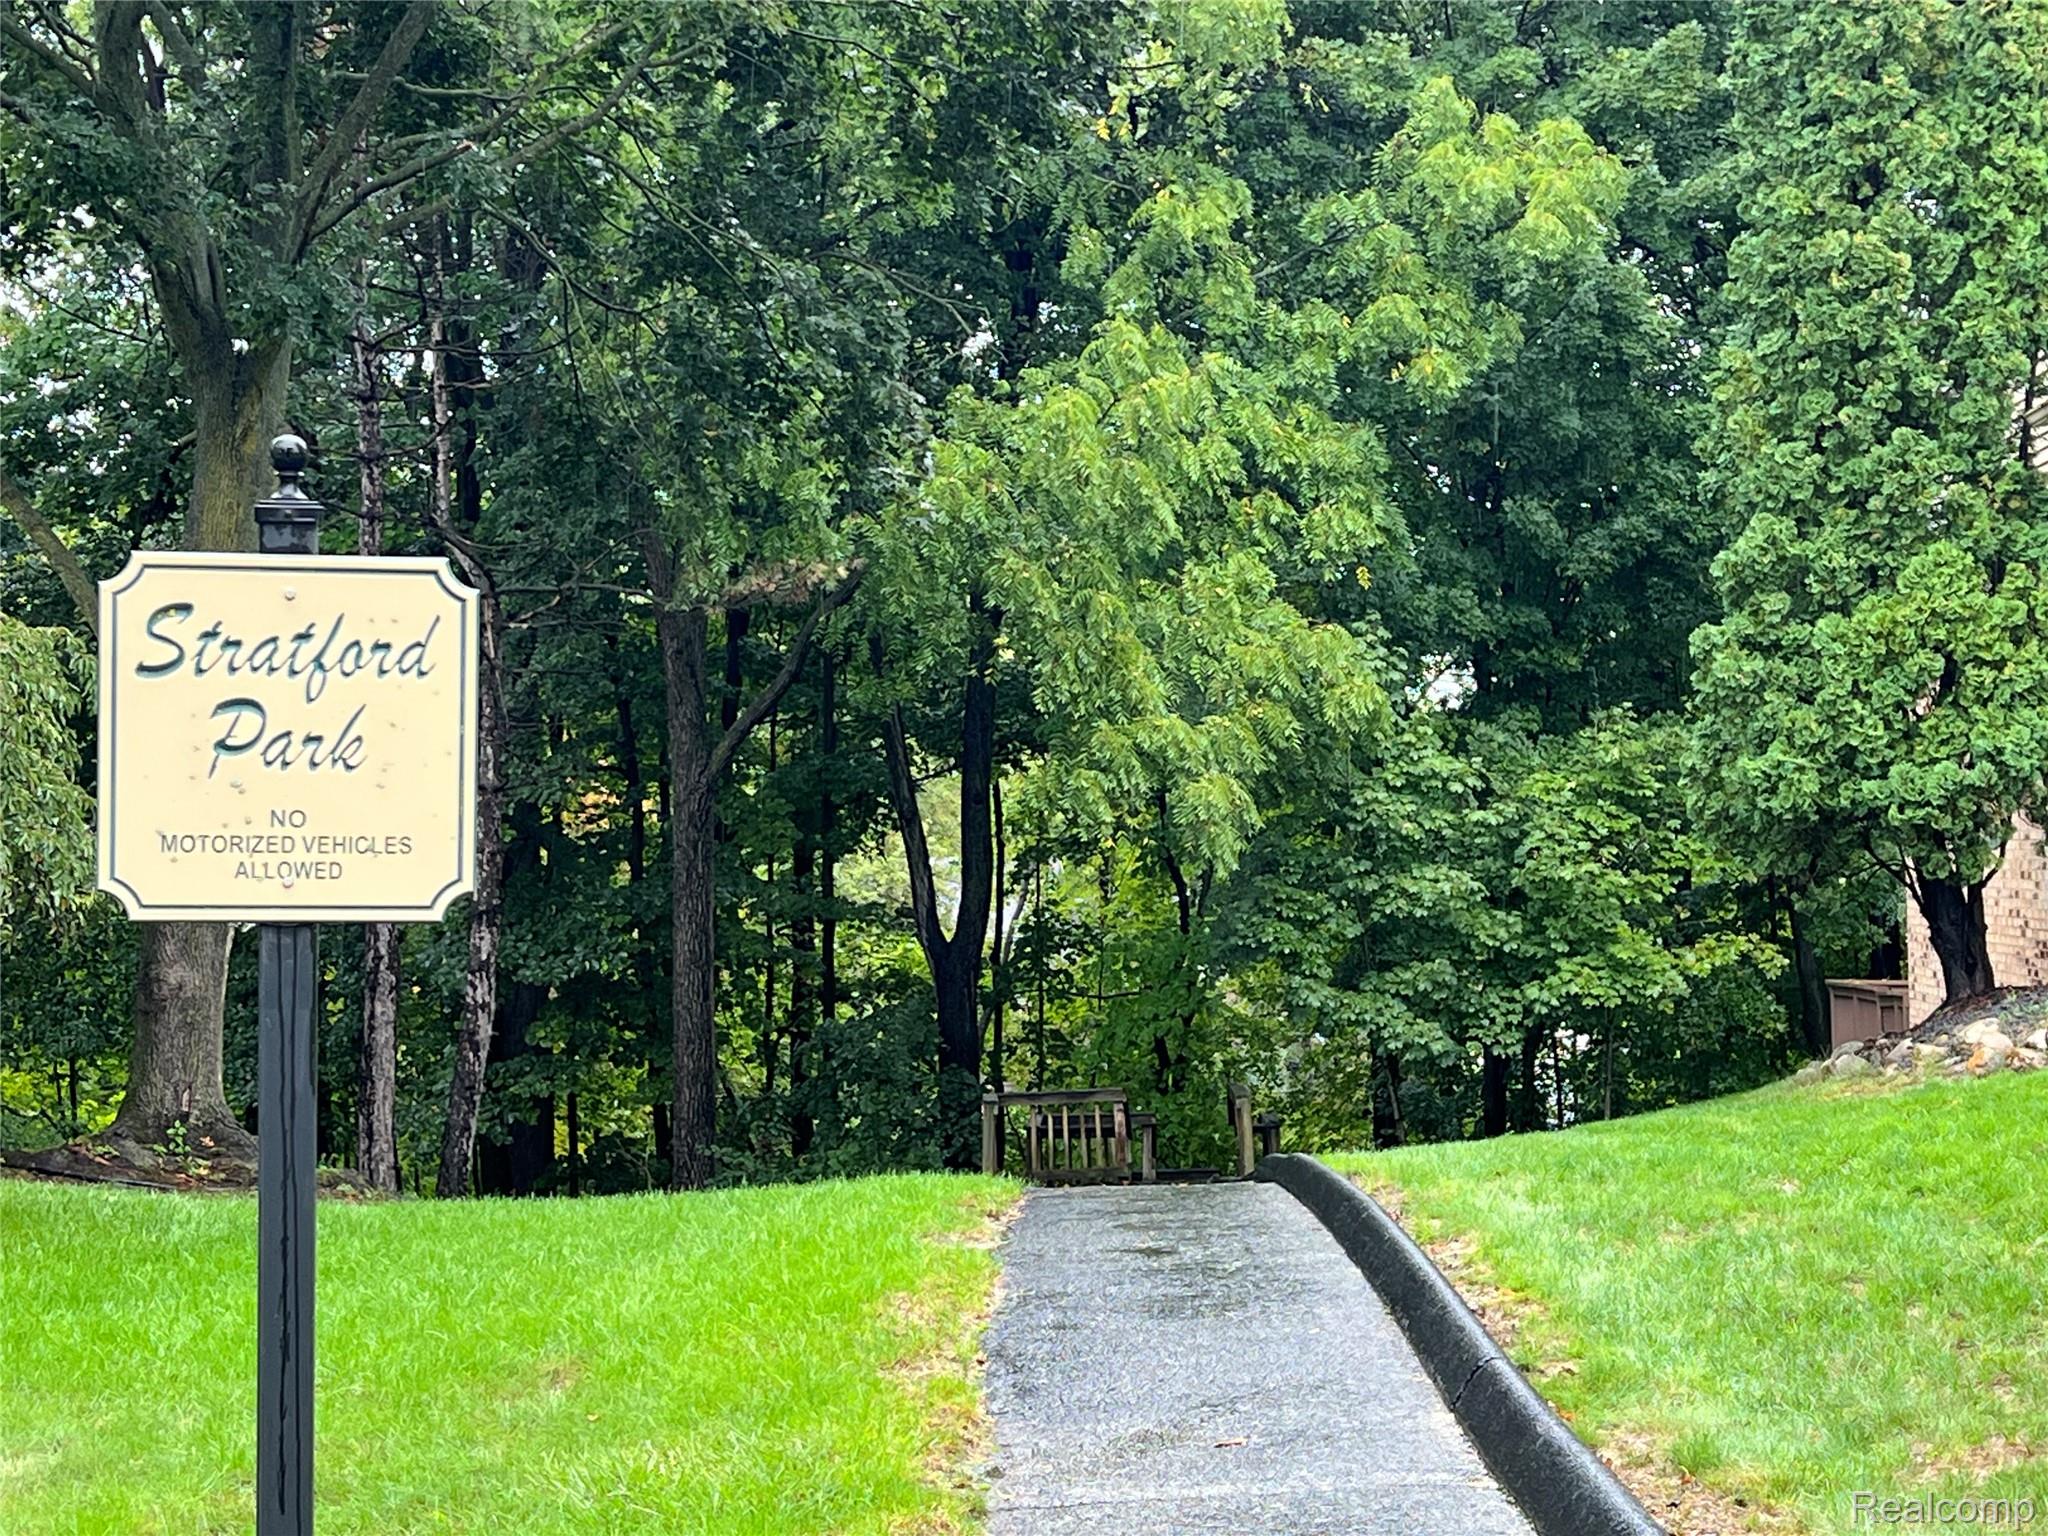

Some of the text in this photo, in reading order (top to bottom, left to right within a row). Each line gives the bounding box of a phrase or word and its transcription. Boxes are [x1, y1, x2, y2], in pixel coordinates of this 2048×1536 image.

[134, 602, 441, 703] Stratford
[208, 697, 368, 779] Park
[270, 809, 307, 829] NO
[160, 834, 413, 855] MOTORIZED VEHICLES
[234, 861, 343, 880] ALLOWED
